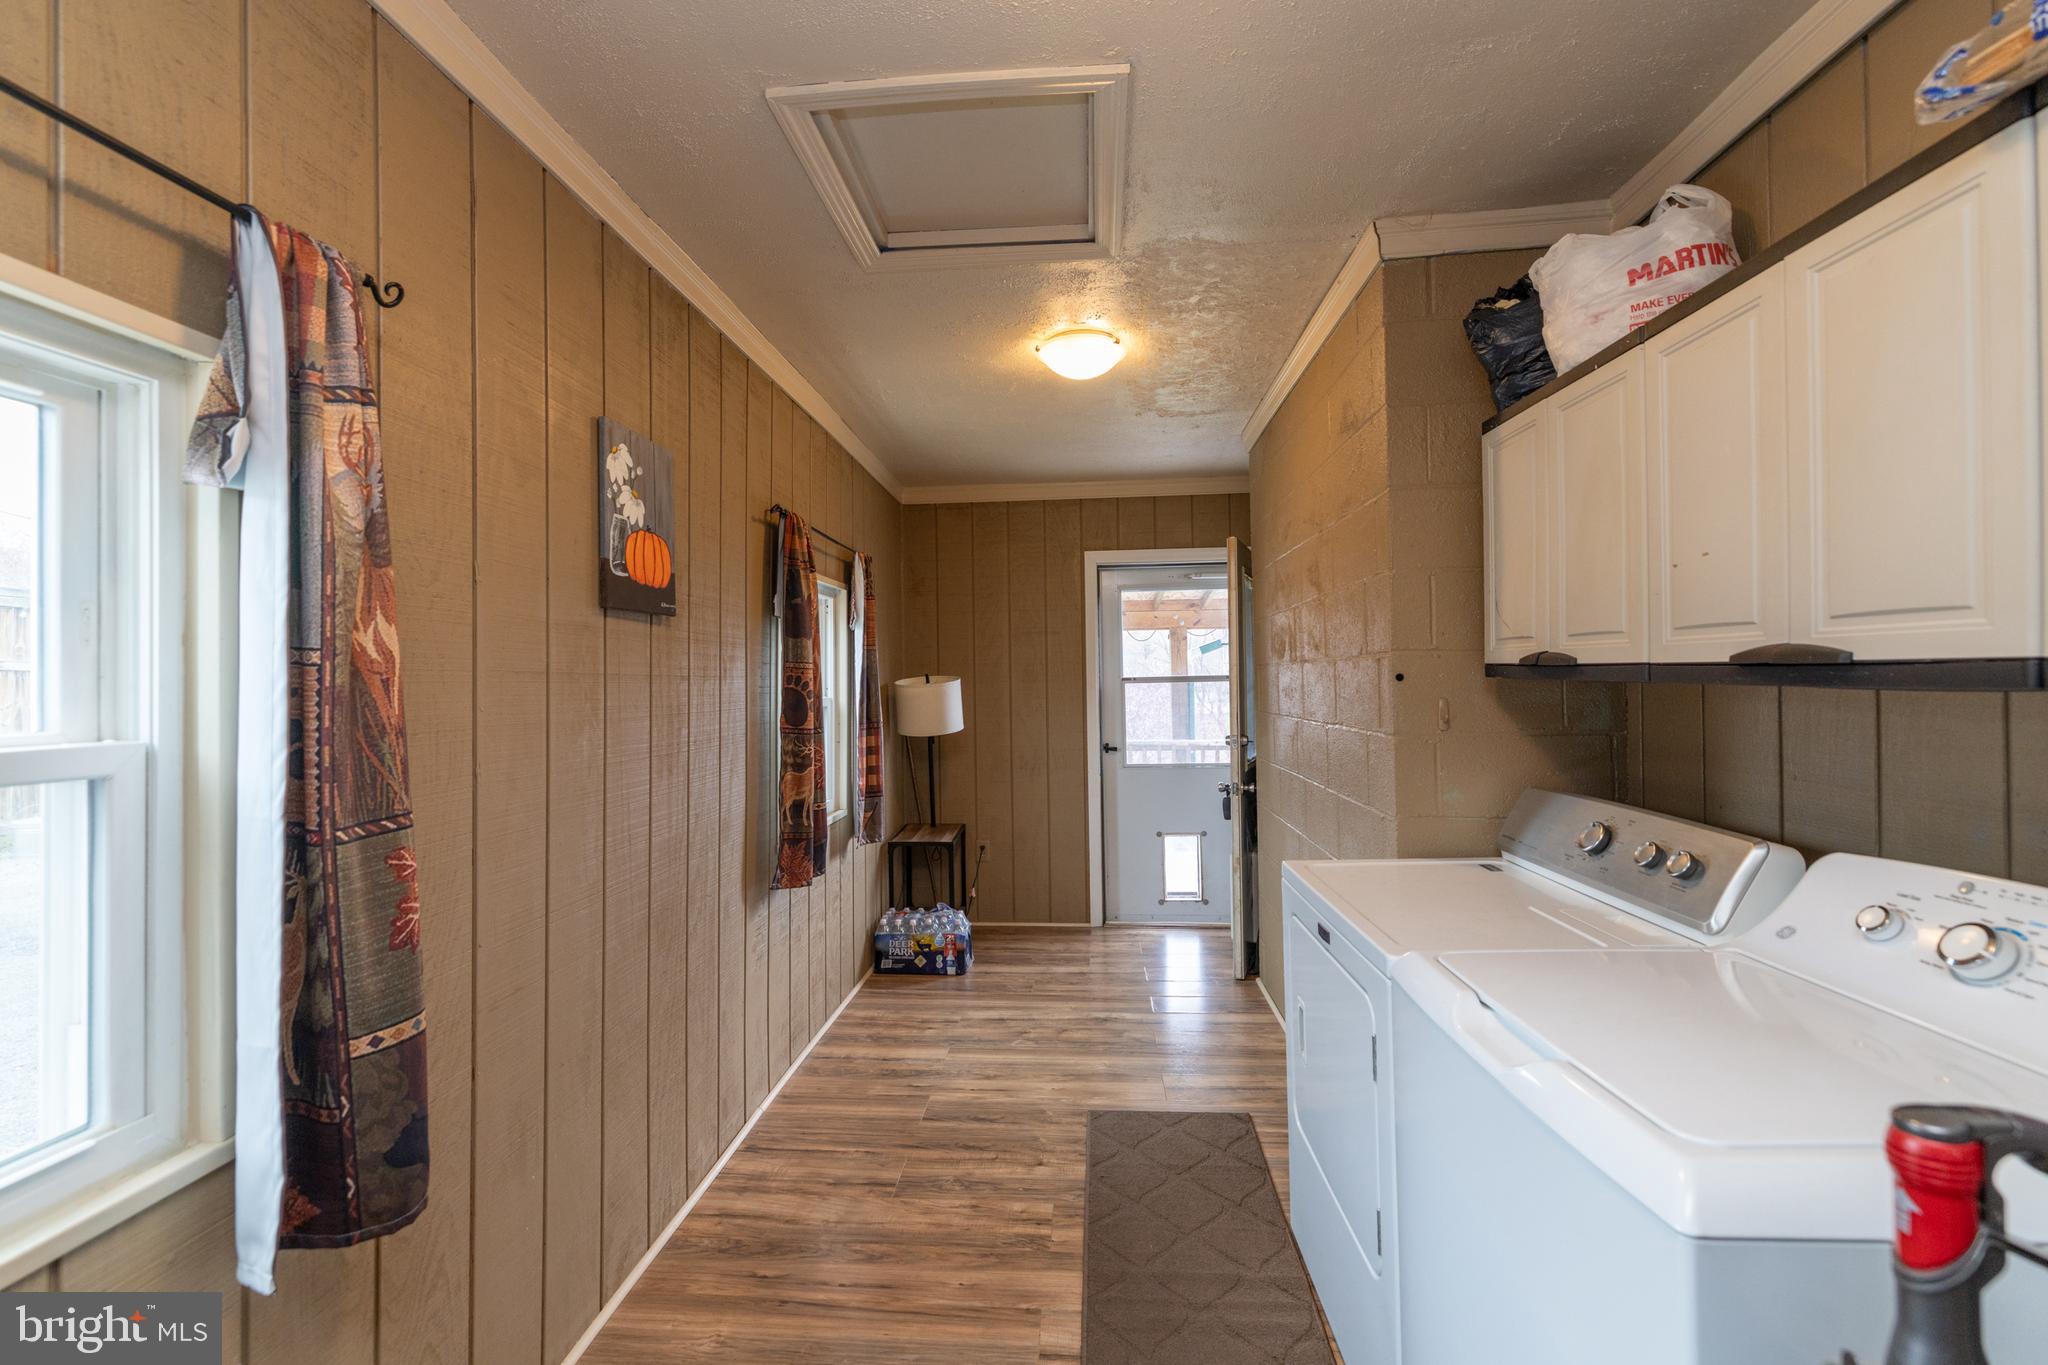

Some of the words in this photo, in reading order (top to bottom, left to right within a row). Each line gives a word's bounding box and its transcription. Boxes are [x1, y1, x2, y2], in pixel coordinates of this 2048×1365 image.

[1627, 243, 1738, 287] MARTIN'S
[1630, 297, 1664, 312] MAKE
[889, 939, 914, 948] DEER
[889, 948, 914, 956] PARK
